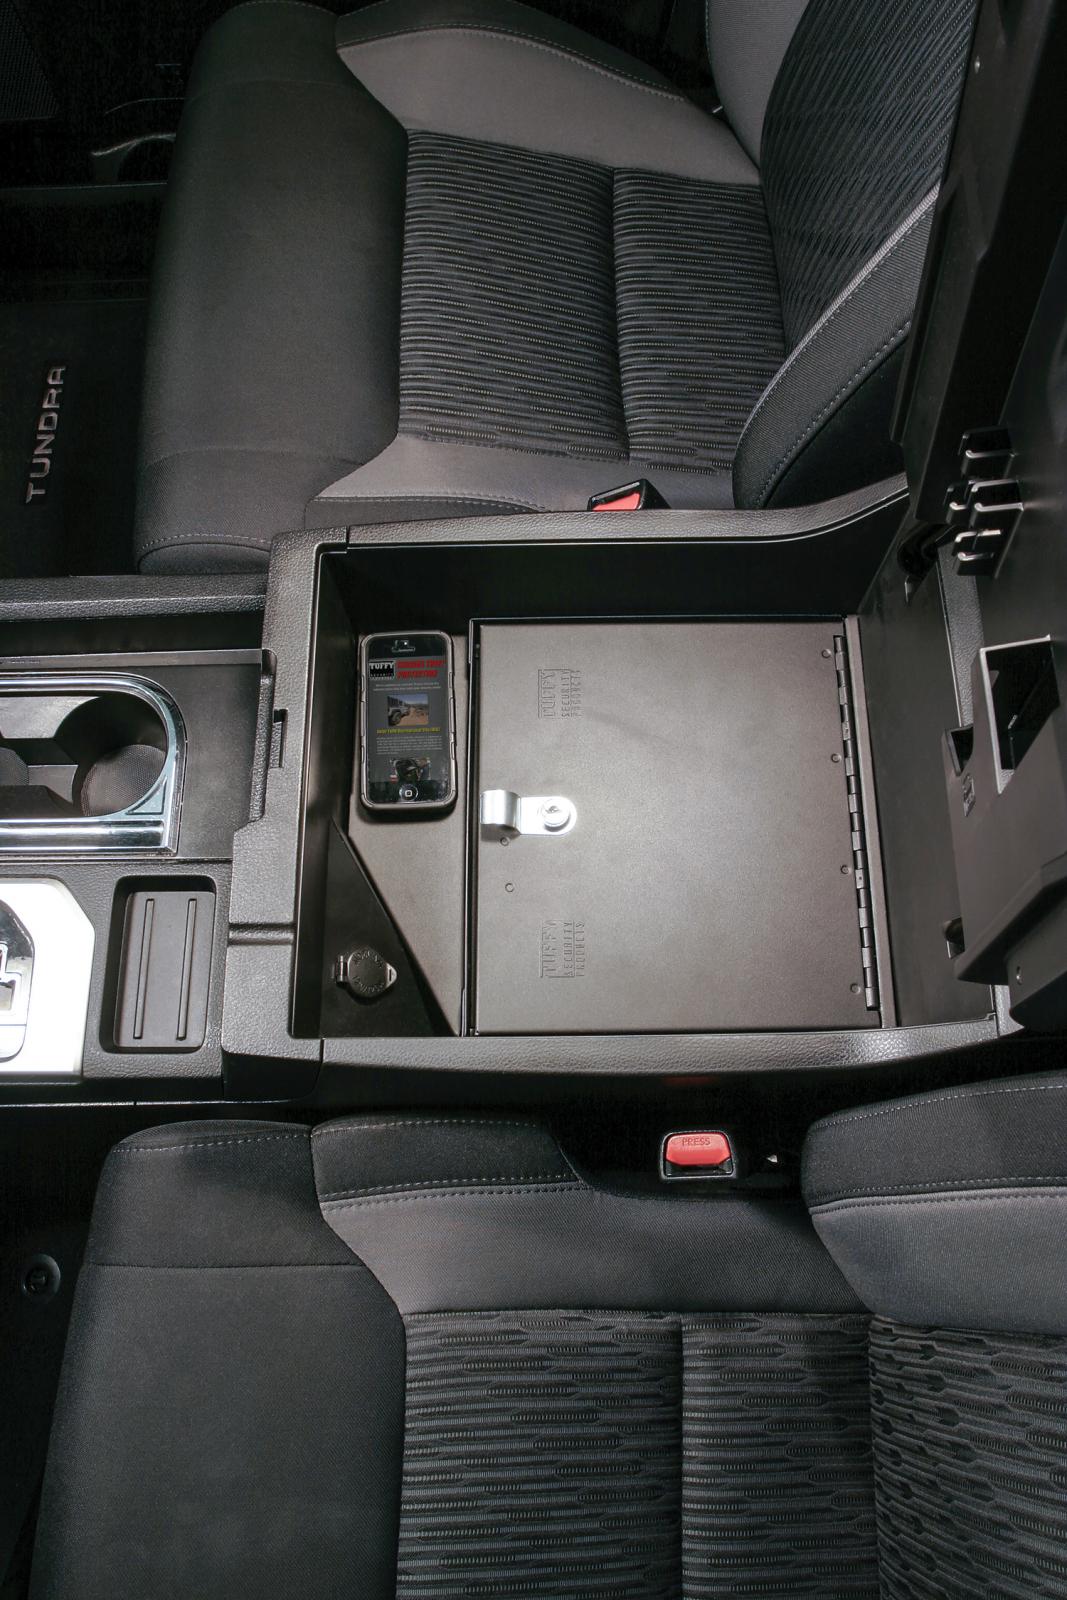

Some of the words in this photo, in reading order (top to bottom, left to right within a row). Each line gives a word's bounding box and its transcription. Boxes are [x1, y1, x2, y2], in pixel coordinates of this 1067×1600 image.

[26, 366, 65, 503] TUNDRA
[369, 662, 394, 670] TUFFY
[541, 671, 556, 718] TUFFY
[542, 920, 556, 976] TUFFY
[682, 1137, 711, 1146] PRESS
